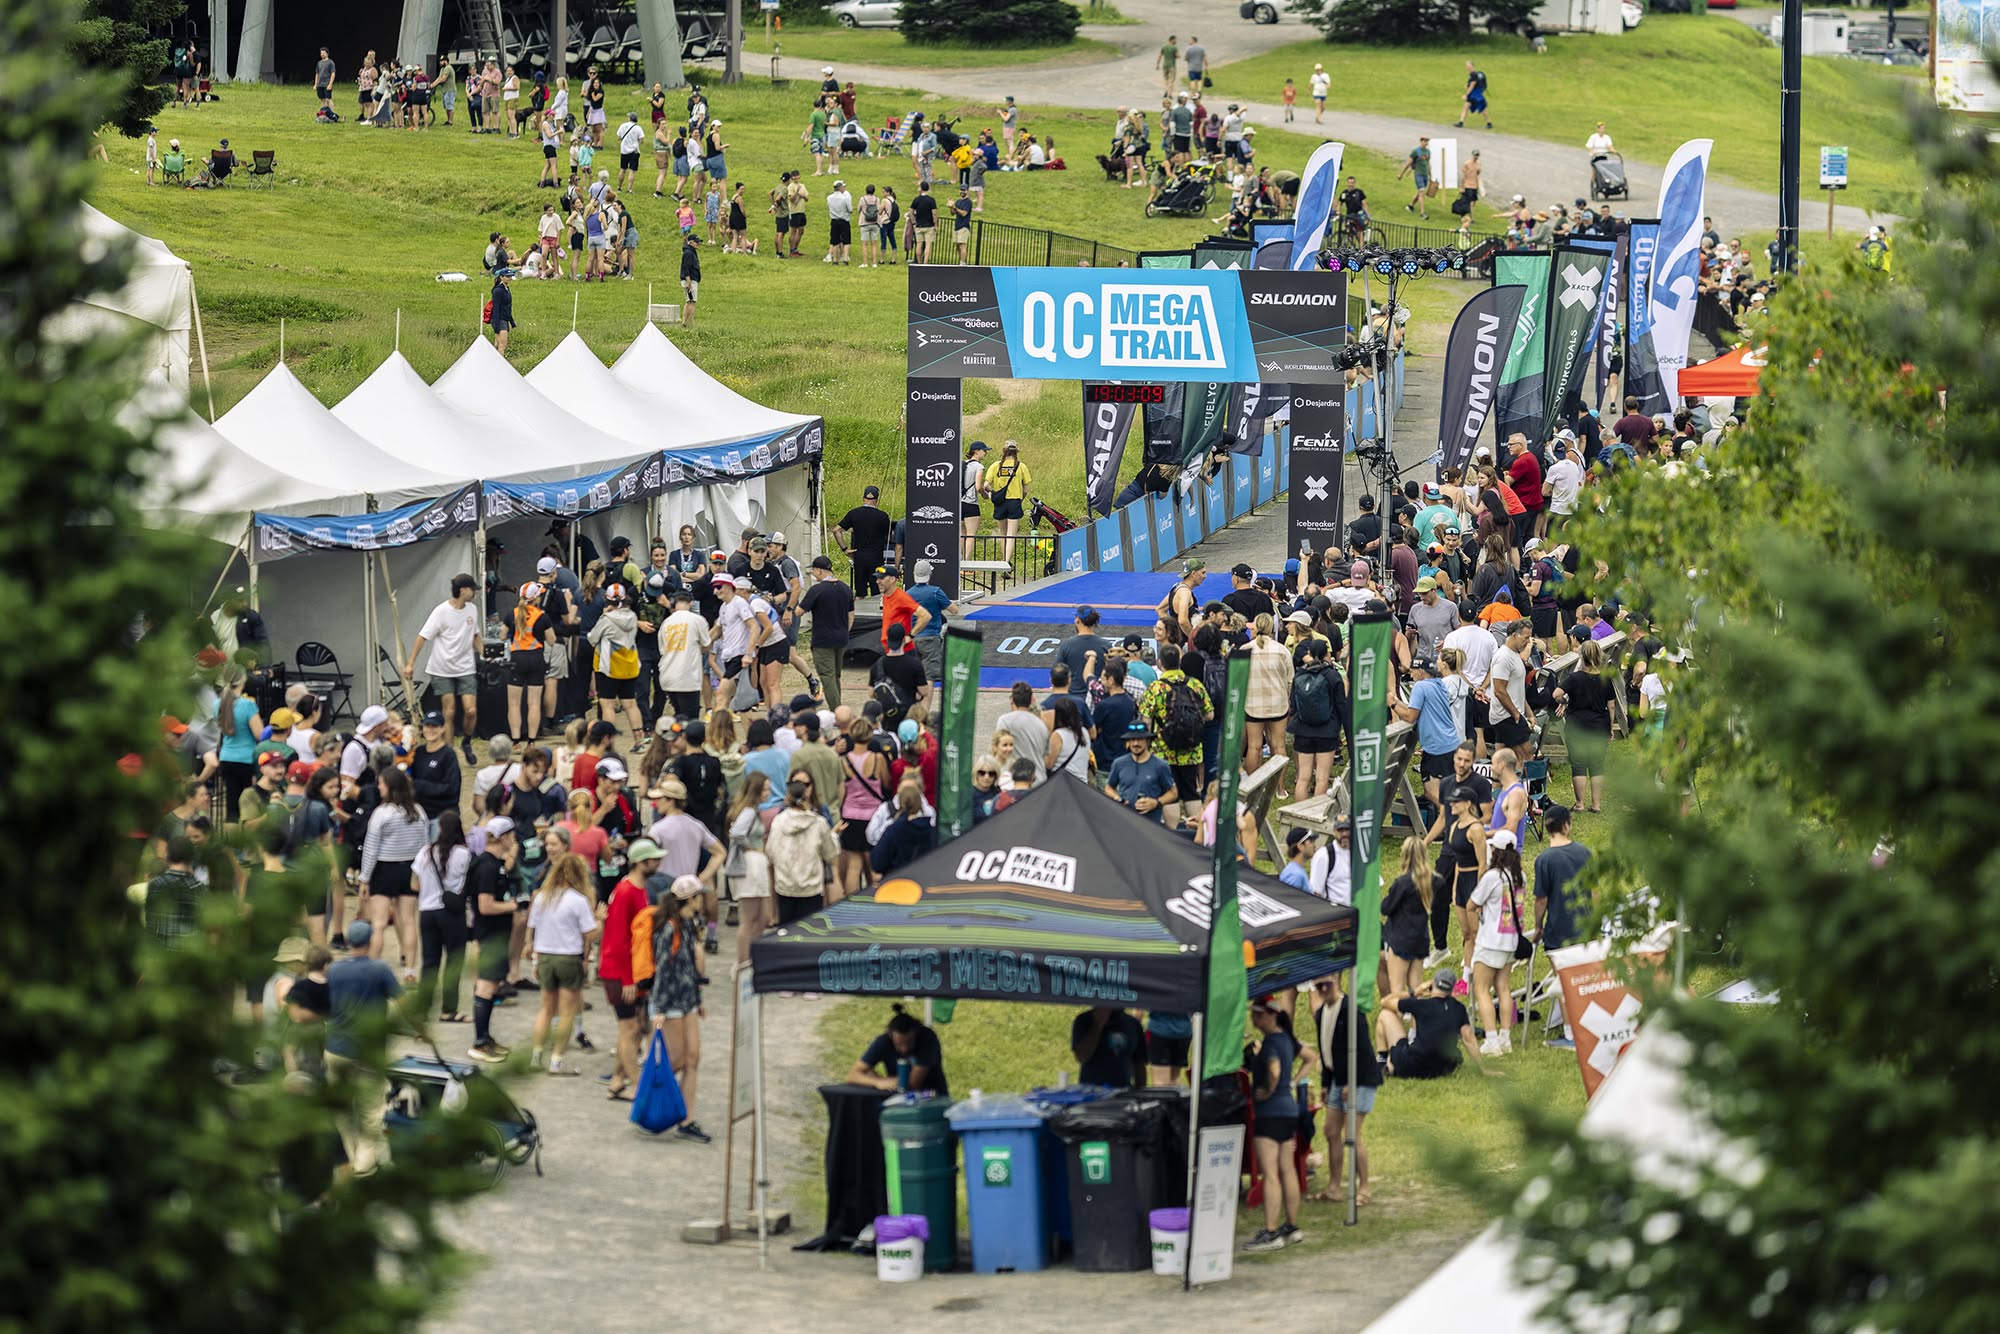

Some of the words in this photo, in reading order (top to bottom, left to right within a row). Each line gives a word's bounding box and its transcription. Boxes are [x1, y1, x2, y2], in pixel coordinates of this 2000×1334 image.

[1571, 283, 1592, 292] XACT
[919, 290, 961, 303] Québec
[1250, 293, 1337, 306] SALOMON
[1110, 293, 1208, 328] MEGA
[1022, 290, 1095, 363] QC
[1110, 329, 1202, 360] TRAIL
[962, 356, 996, 365] CHARLEVOIX
[921, 392, 957, 401] Desjardins
[1094, 385, 1164, 403] 19:03:09
[1305, 399, 1341, 408] Desjardins
[911, 436, 920, 444] LA
[920, 436, 947, 445] SOUCHE
[916, 468, 945, 480] PCN
[916, 480, 945, 488] Physio
[1296, 519, 1335, 527] icebreaker
[996, 636, 1061, 655] QC
[955, 849, 1008, 881] QC
[1013, 853, 1068, 873] MEGA
[1010, 867, 1056, 884] TRAIL
[818, 944, 942, 992] QUÉBEC
[949, 946, 1042, 994] MEGA
[1044, 954, 1138, 1001] TRAIL
[1601, 1029, 1631, 1042] XACT
